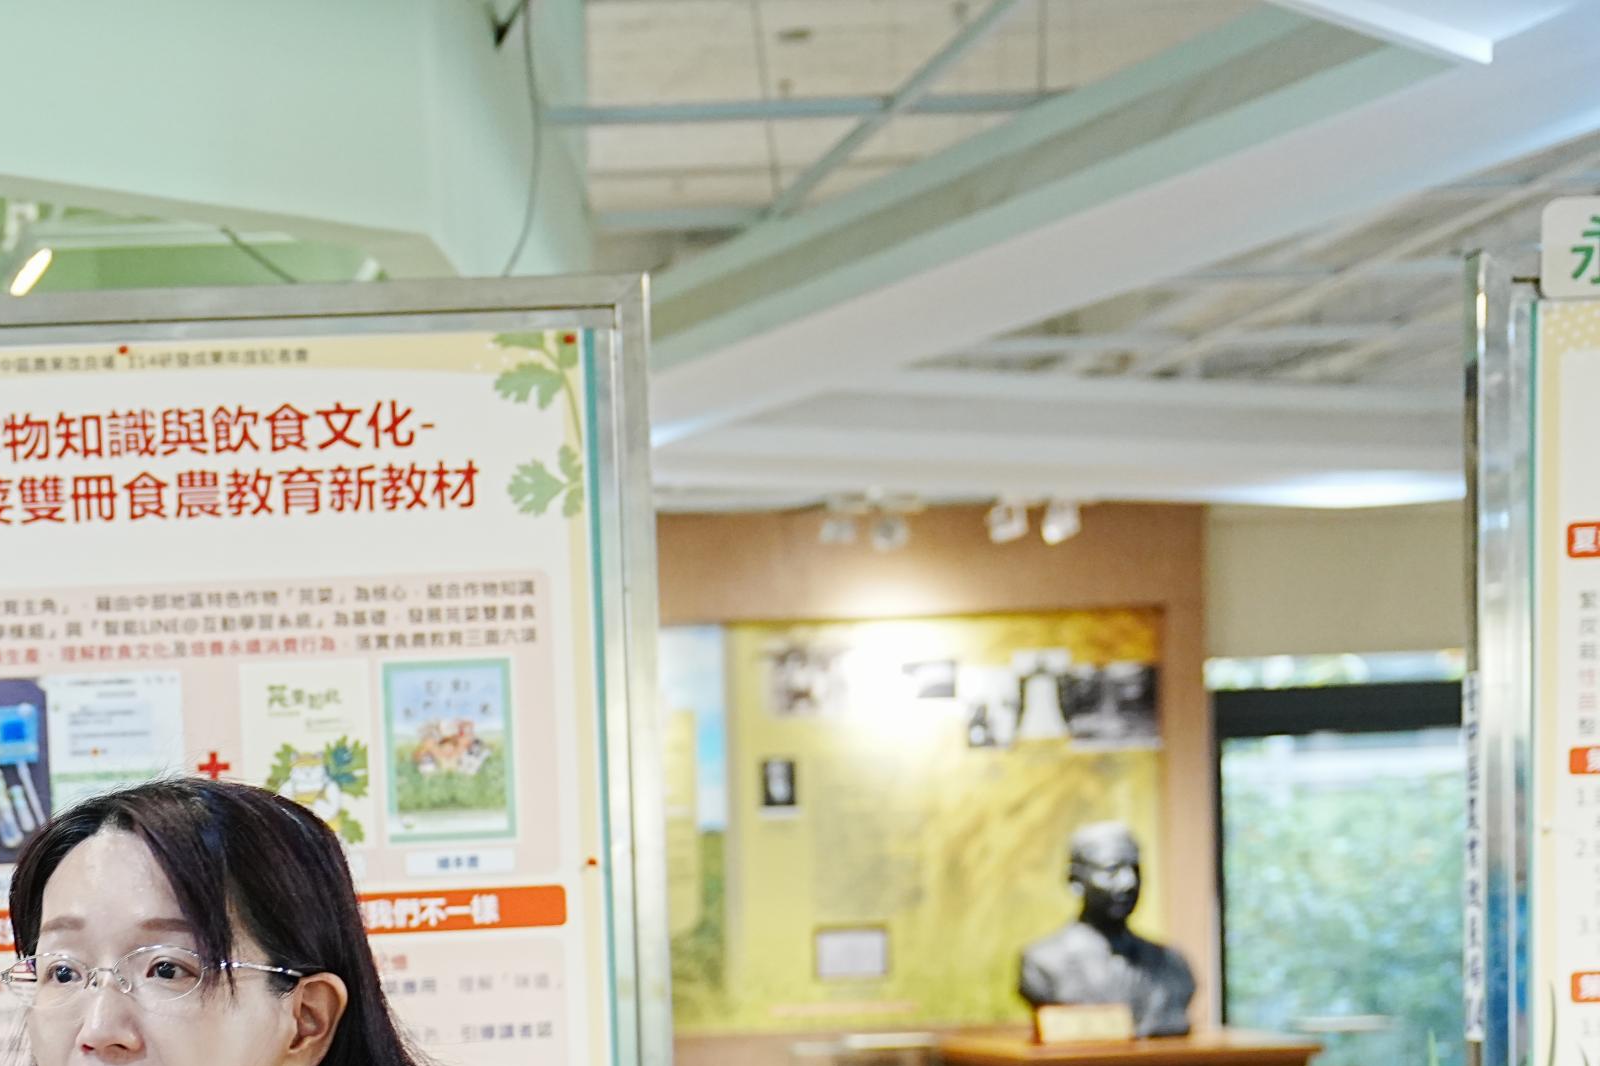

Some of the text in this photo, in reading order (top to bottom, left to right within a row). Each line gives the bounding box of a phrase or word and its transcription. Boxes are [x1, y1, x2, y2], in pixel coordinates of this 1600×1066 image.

[361, 894, 499, 930] 我們不一樣
